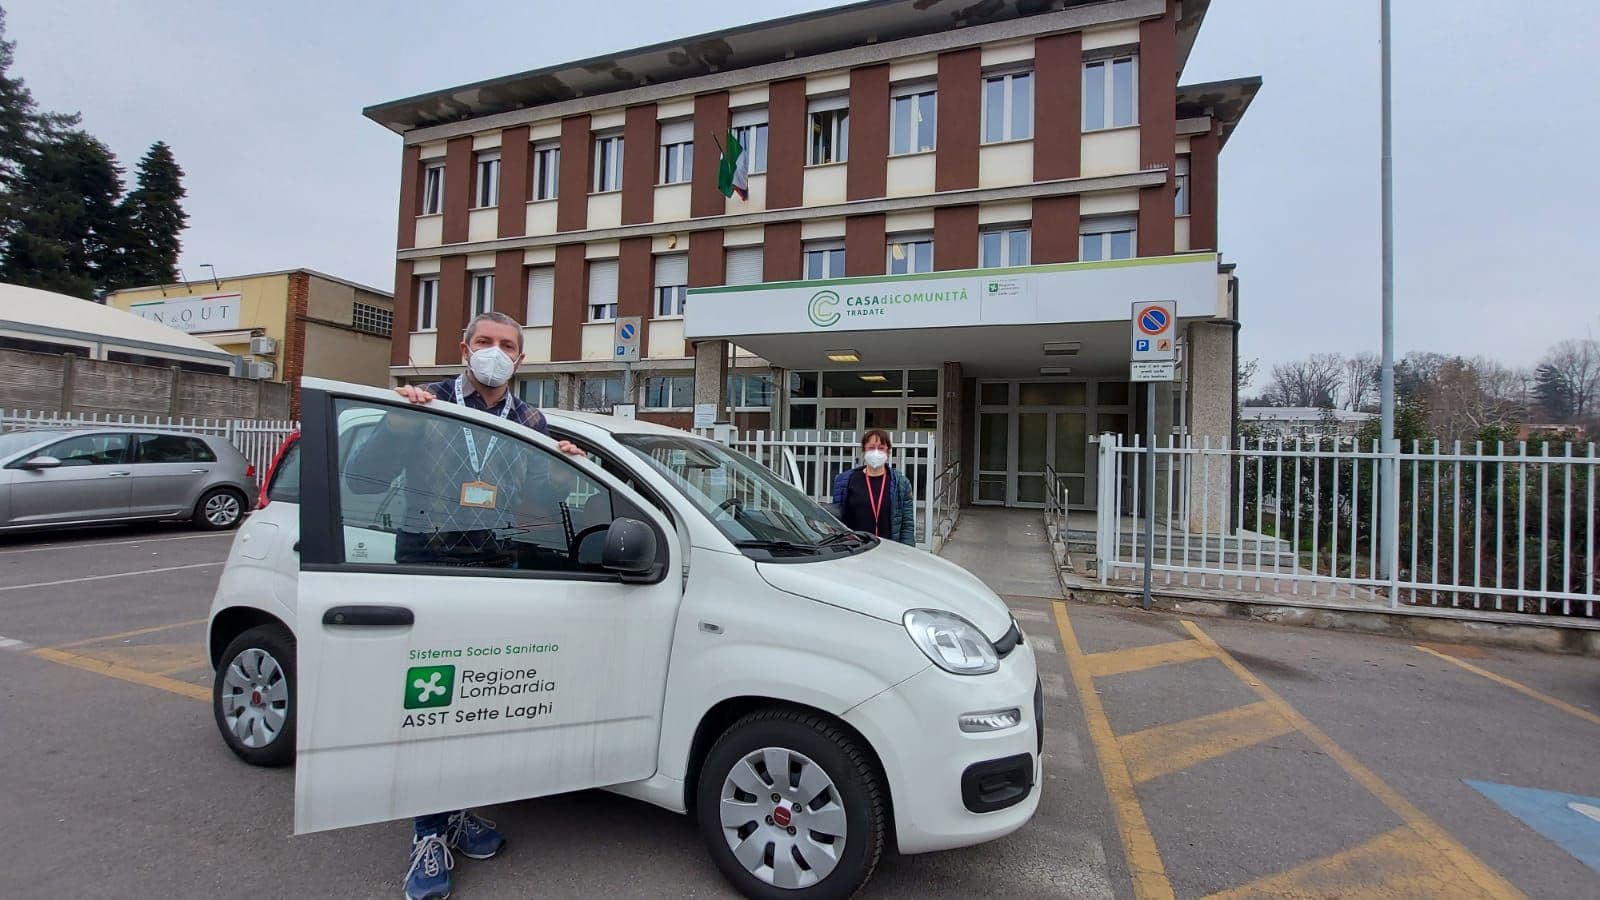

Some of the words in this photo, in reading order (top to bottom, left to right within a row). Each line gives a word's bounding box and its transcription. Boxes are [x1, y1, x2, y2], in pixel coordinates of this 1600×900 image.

[846, 288, 968, 306] CASAdiCOMUNITÀ
[181, 305, 229, 322] OUT
[847, 309, 885, 317] TRADATE
[1138, 341, 1146, 350] P
[409, 649, 462, 660] Sistema
[466, 645, 502, 657] Socio
[505, 643, 559, 655] Sanitario
[461, 668, 537, 685] Regione
[460, 679, 555, 699] Lombardia
[402, 711, 449, 728] ASST
[455, 707, 500, 723] Sette
[505, 702, 553, 719] Laghi
